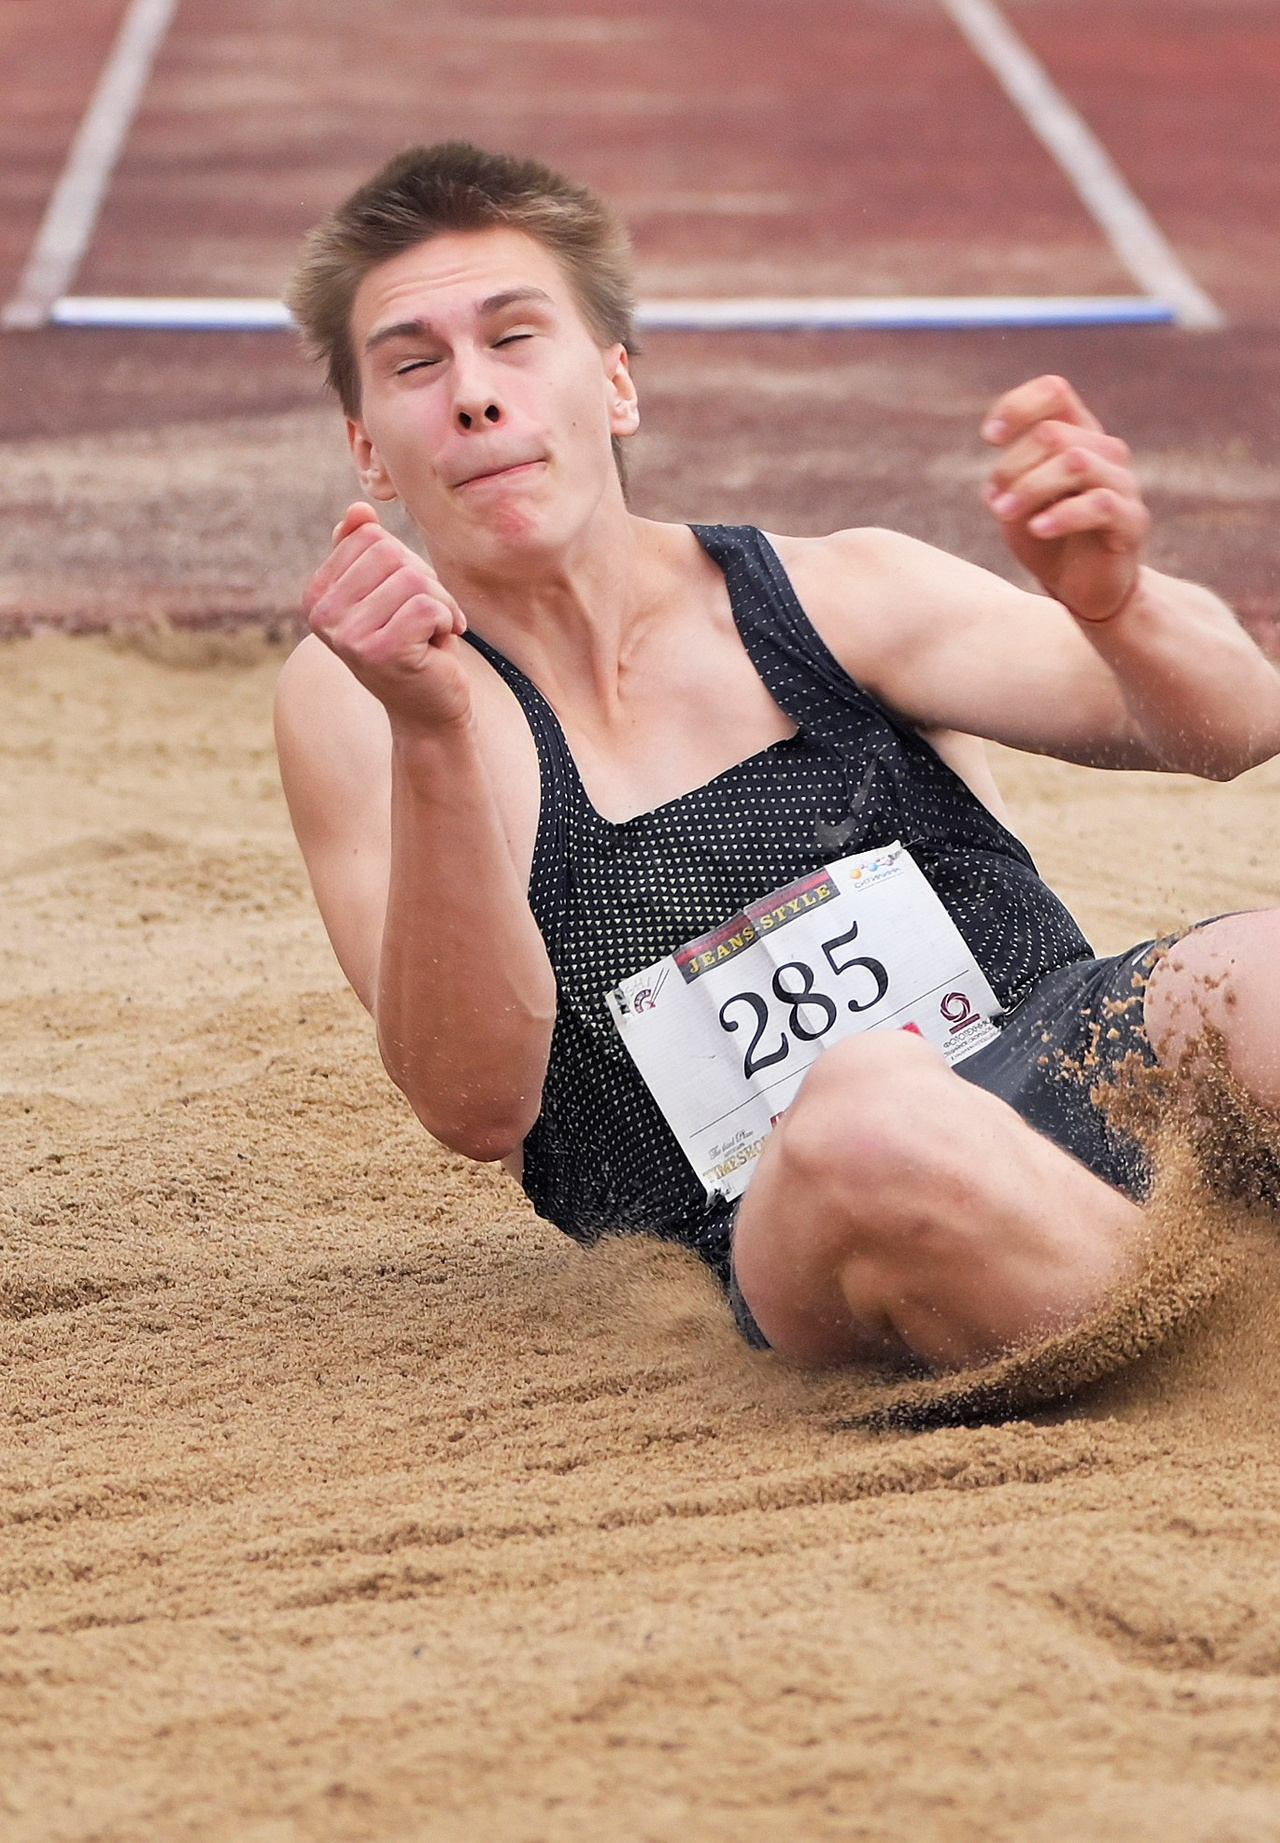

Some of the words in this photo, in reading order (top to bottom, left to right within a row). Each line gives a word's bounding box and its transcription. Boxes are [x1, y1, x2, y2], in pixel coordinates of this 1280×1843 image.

[689, 926, 756, 974] JEANS
[760, 883, 831, 930] STYLE
[719, 920, 889, 1080] 285
